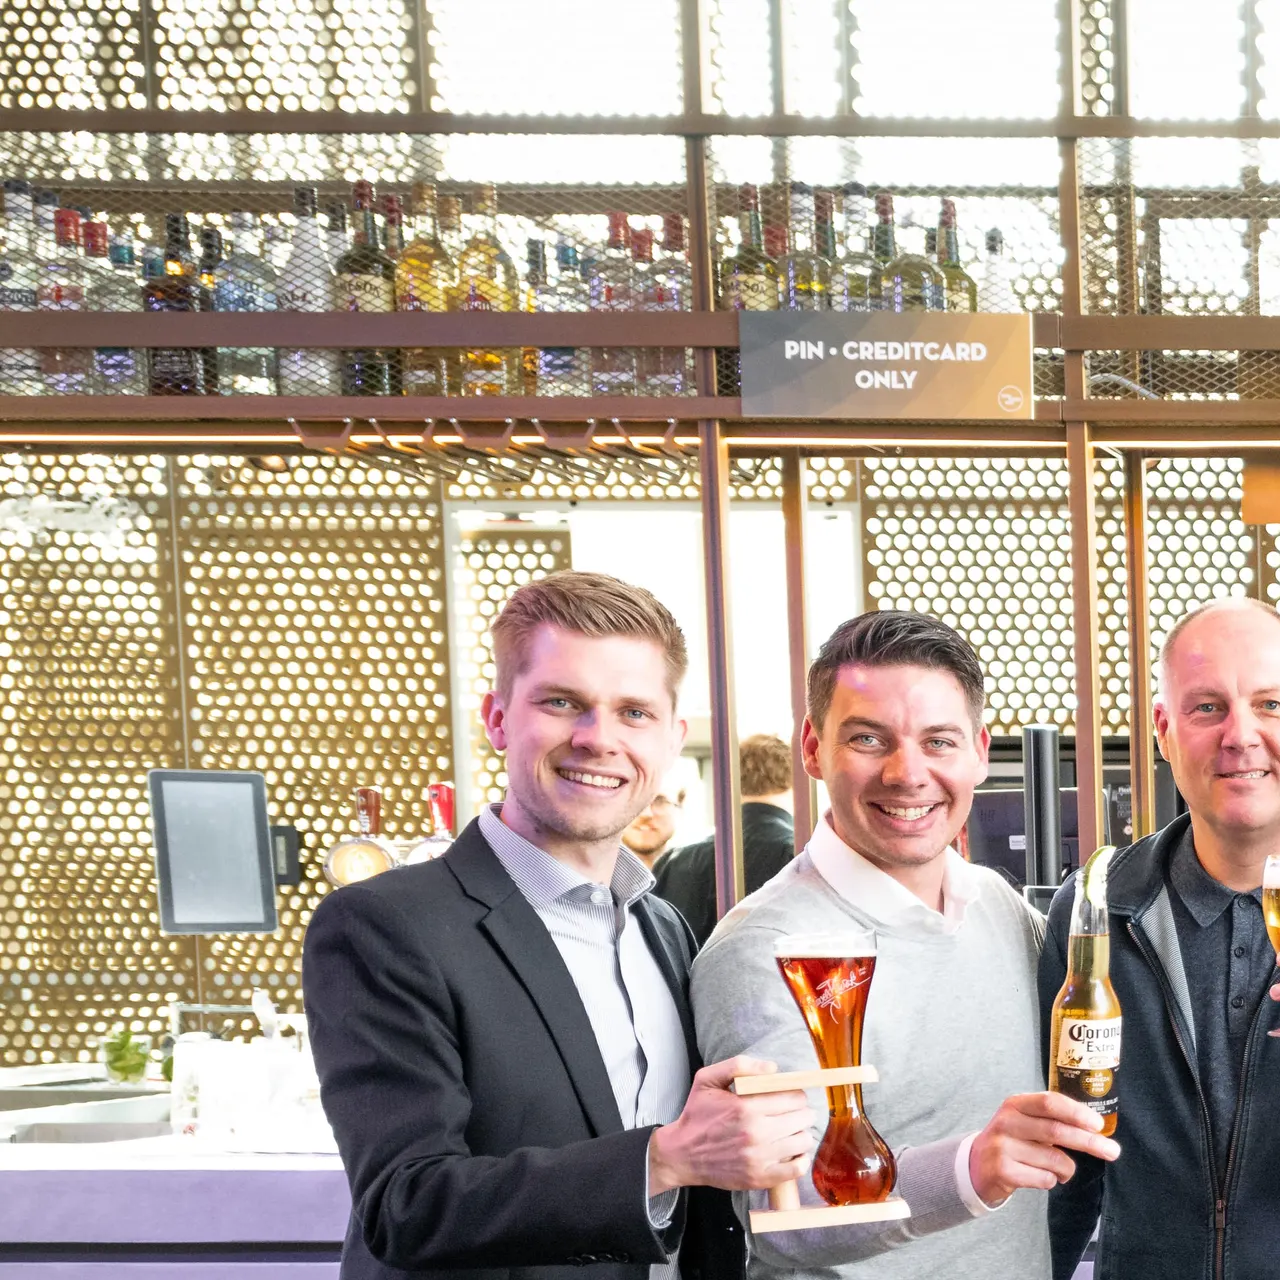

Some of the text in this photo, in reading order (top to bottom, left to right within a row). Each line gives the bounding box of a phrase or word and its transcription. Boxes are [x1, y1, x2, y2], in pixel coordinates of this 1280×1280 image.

[784, 340, 987, 361] PIN CREDITCARD
[855, 369, 918, 390] ONLY
